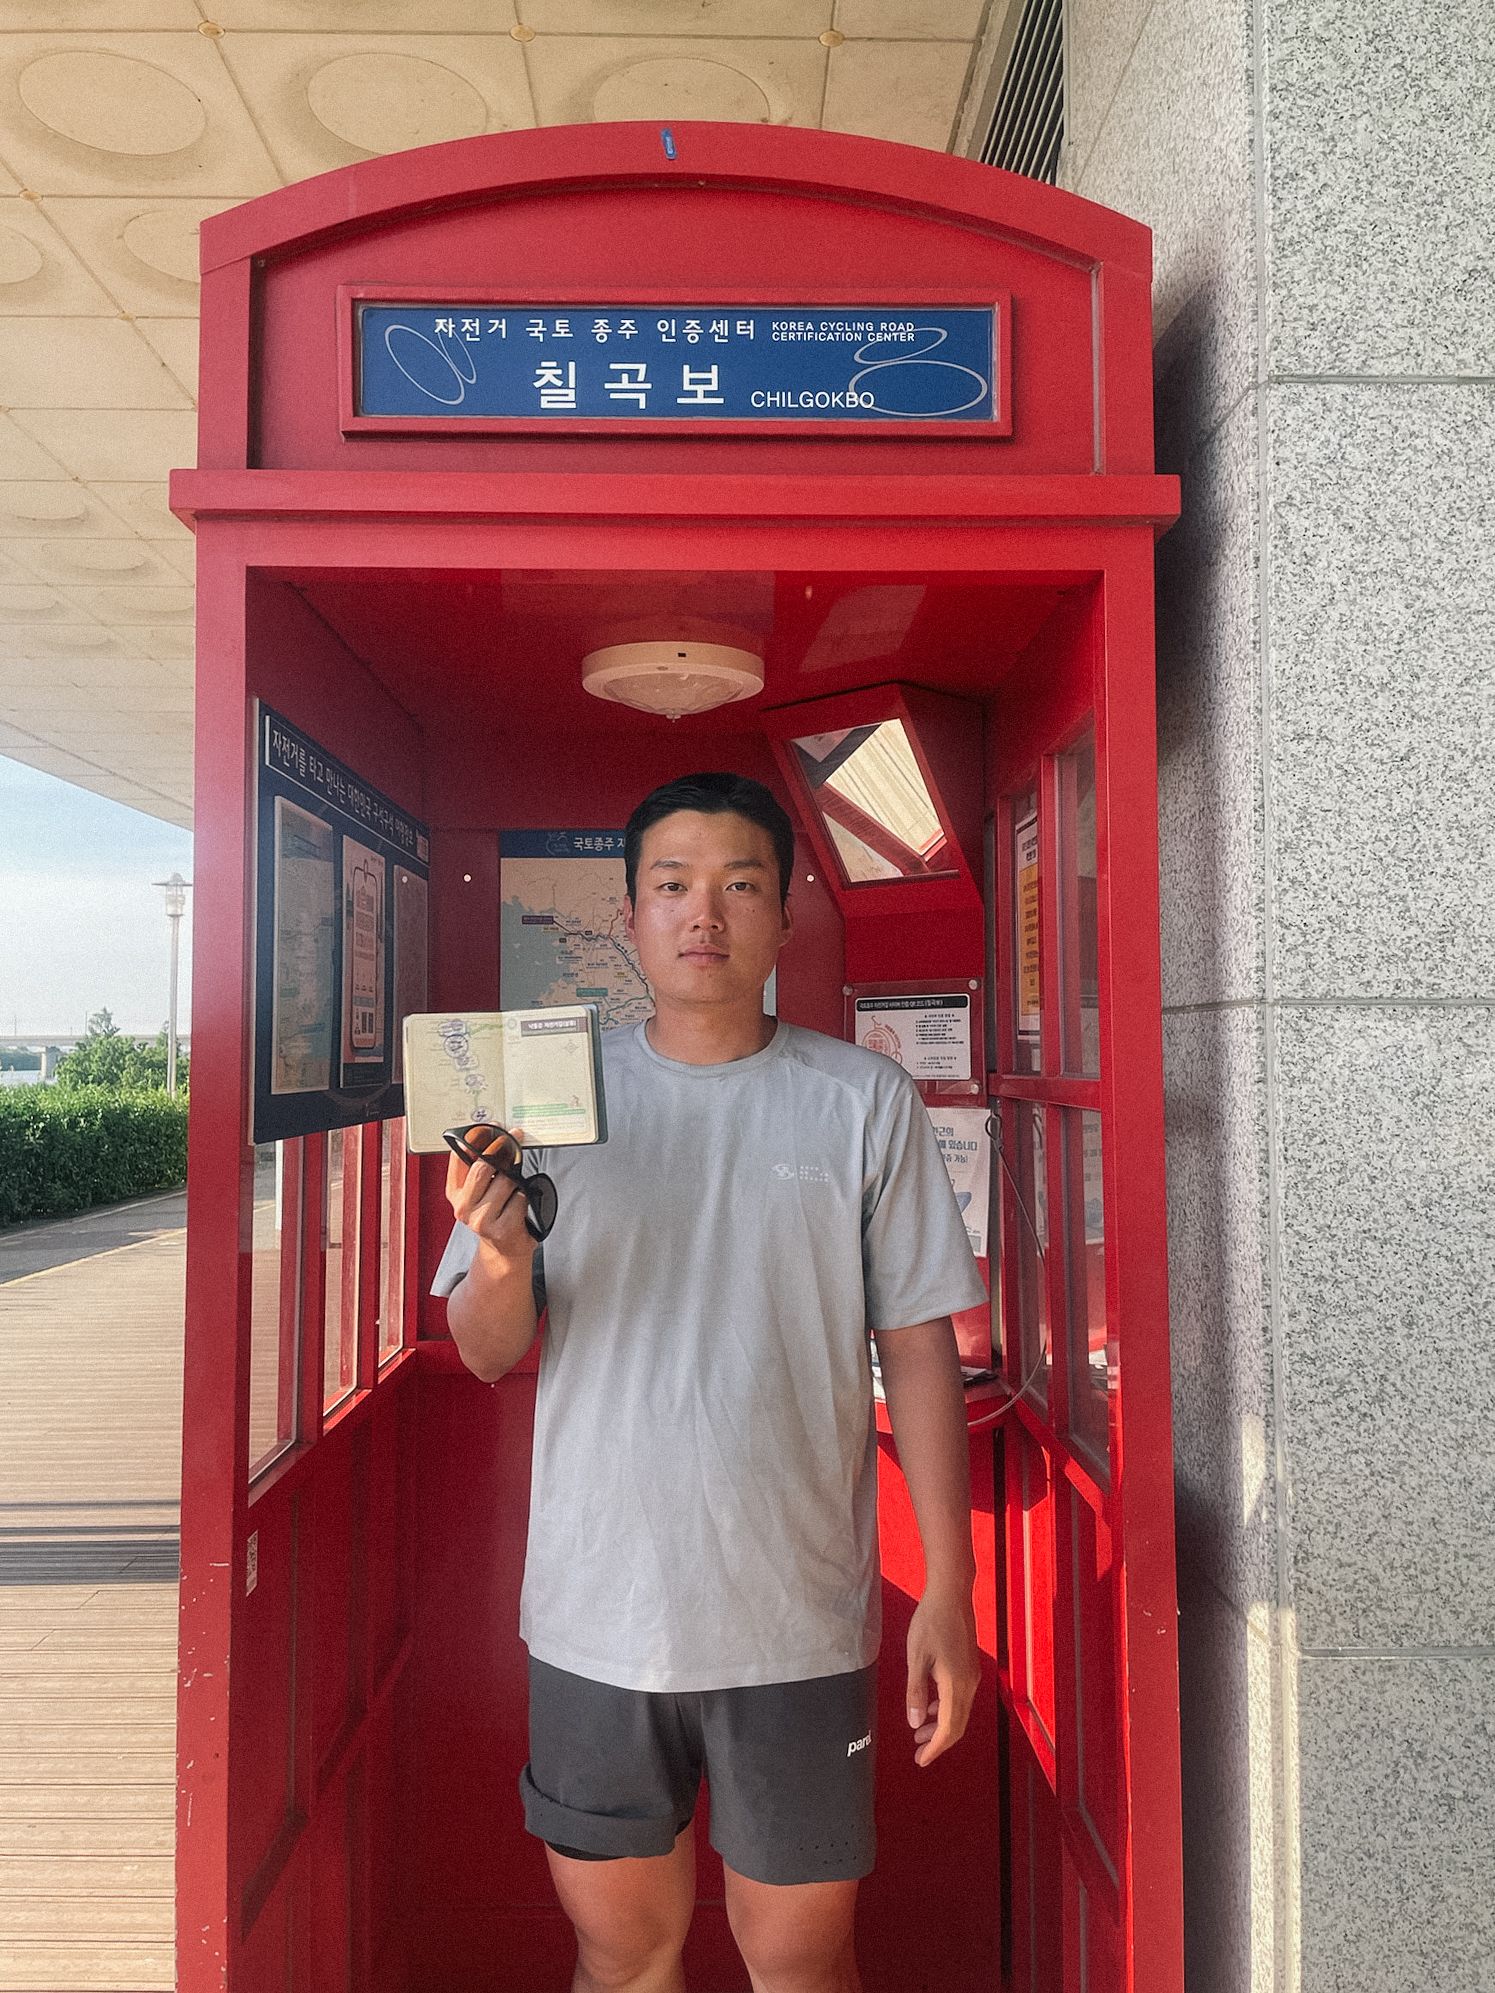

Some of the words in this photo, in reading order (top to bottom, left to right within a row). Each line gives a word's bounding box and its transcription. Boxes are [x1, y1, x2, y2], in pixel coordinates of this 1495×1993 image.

[434, 318, 507, 342] 자전거
[525, 319, 574, 342] 국토
[591, 319, 639, 343] 종주
[657, 319, 755, 344] 인증센터
[772, 321, 814, 331] KOREA
[820, 321, 874, 331] CYCLING
[880, 321, 915, 332] ROAD
[771, 332, 862, 342] CERTIFICATION
[867, 332, 915, 342] CENTER
[532, 361, 725, 409] 칠곡보
[750, 390, 875, 409] CHILGOKBO
[272, 729, 307, 778] 자전거를
[309, 755, 324, 783] 타고
[573, 836, 614, 851] 국토종주
